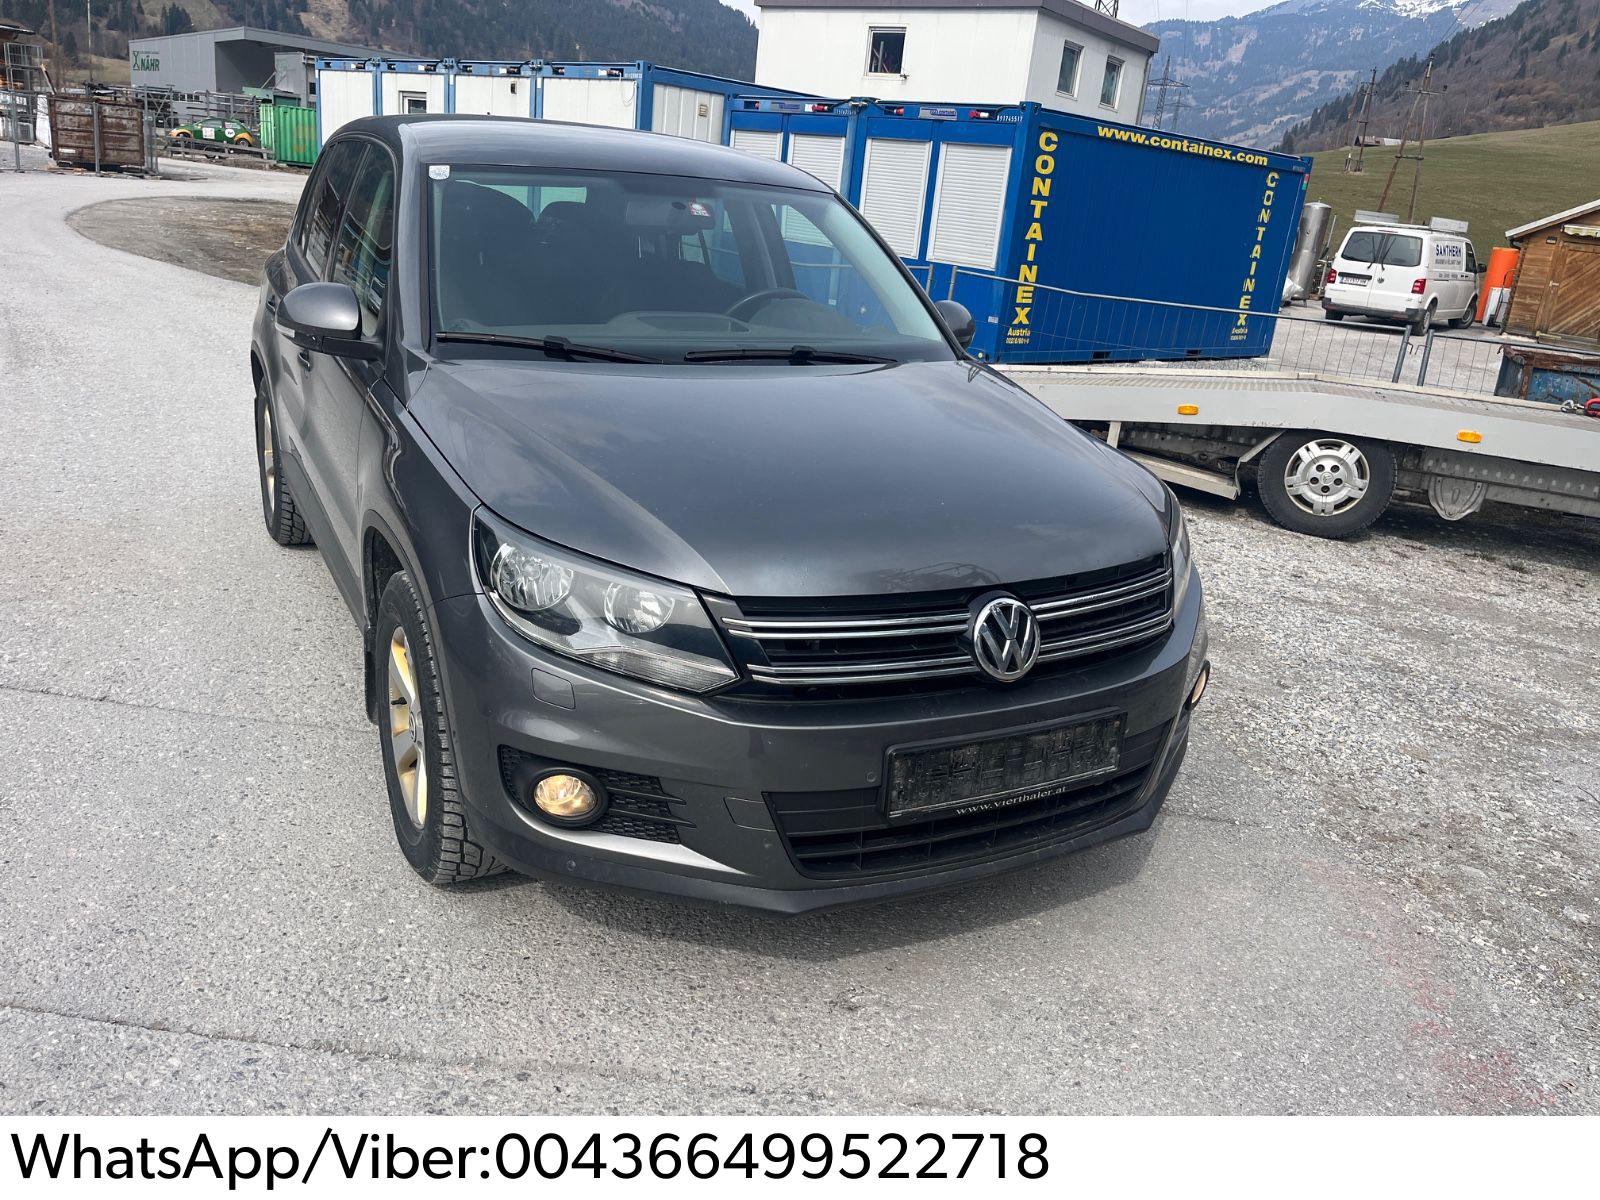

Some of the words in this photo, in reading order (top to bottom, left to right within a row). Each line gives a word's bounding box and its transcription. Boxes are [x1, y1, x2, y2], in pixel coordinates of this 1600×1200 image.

[1097, 125, 1269, 166] www.containex.com
[1012, 131, 1059, 325] CONTAINEX
[1237, 171, 1280, 326] CONTAINEX
